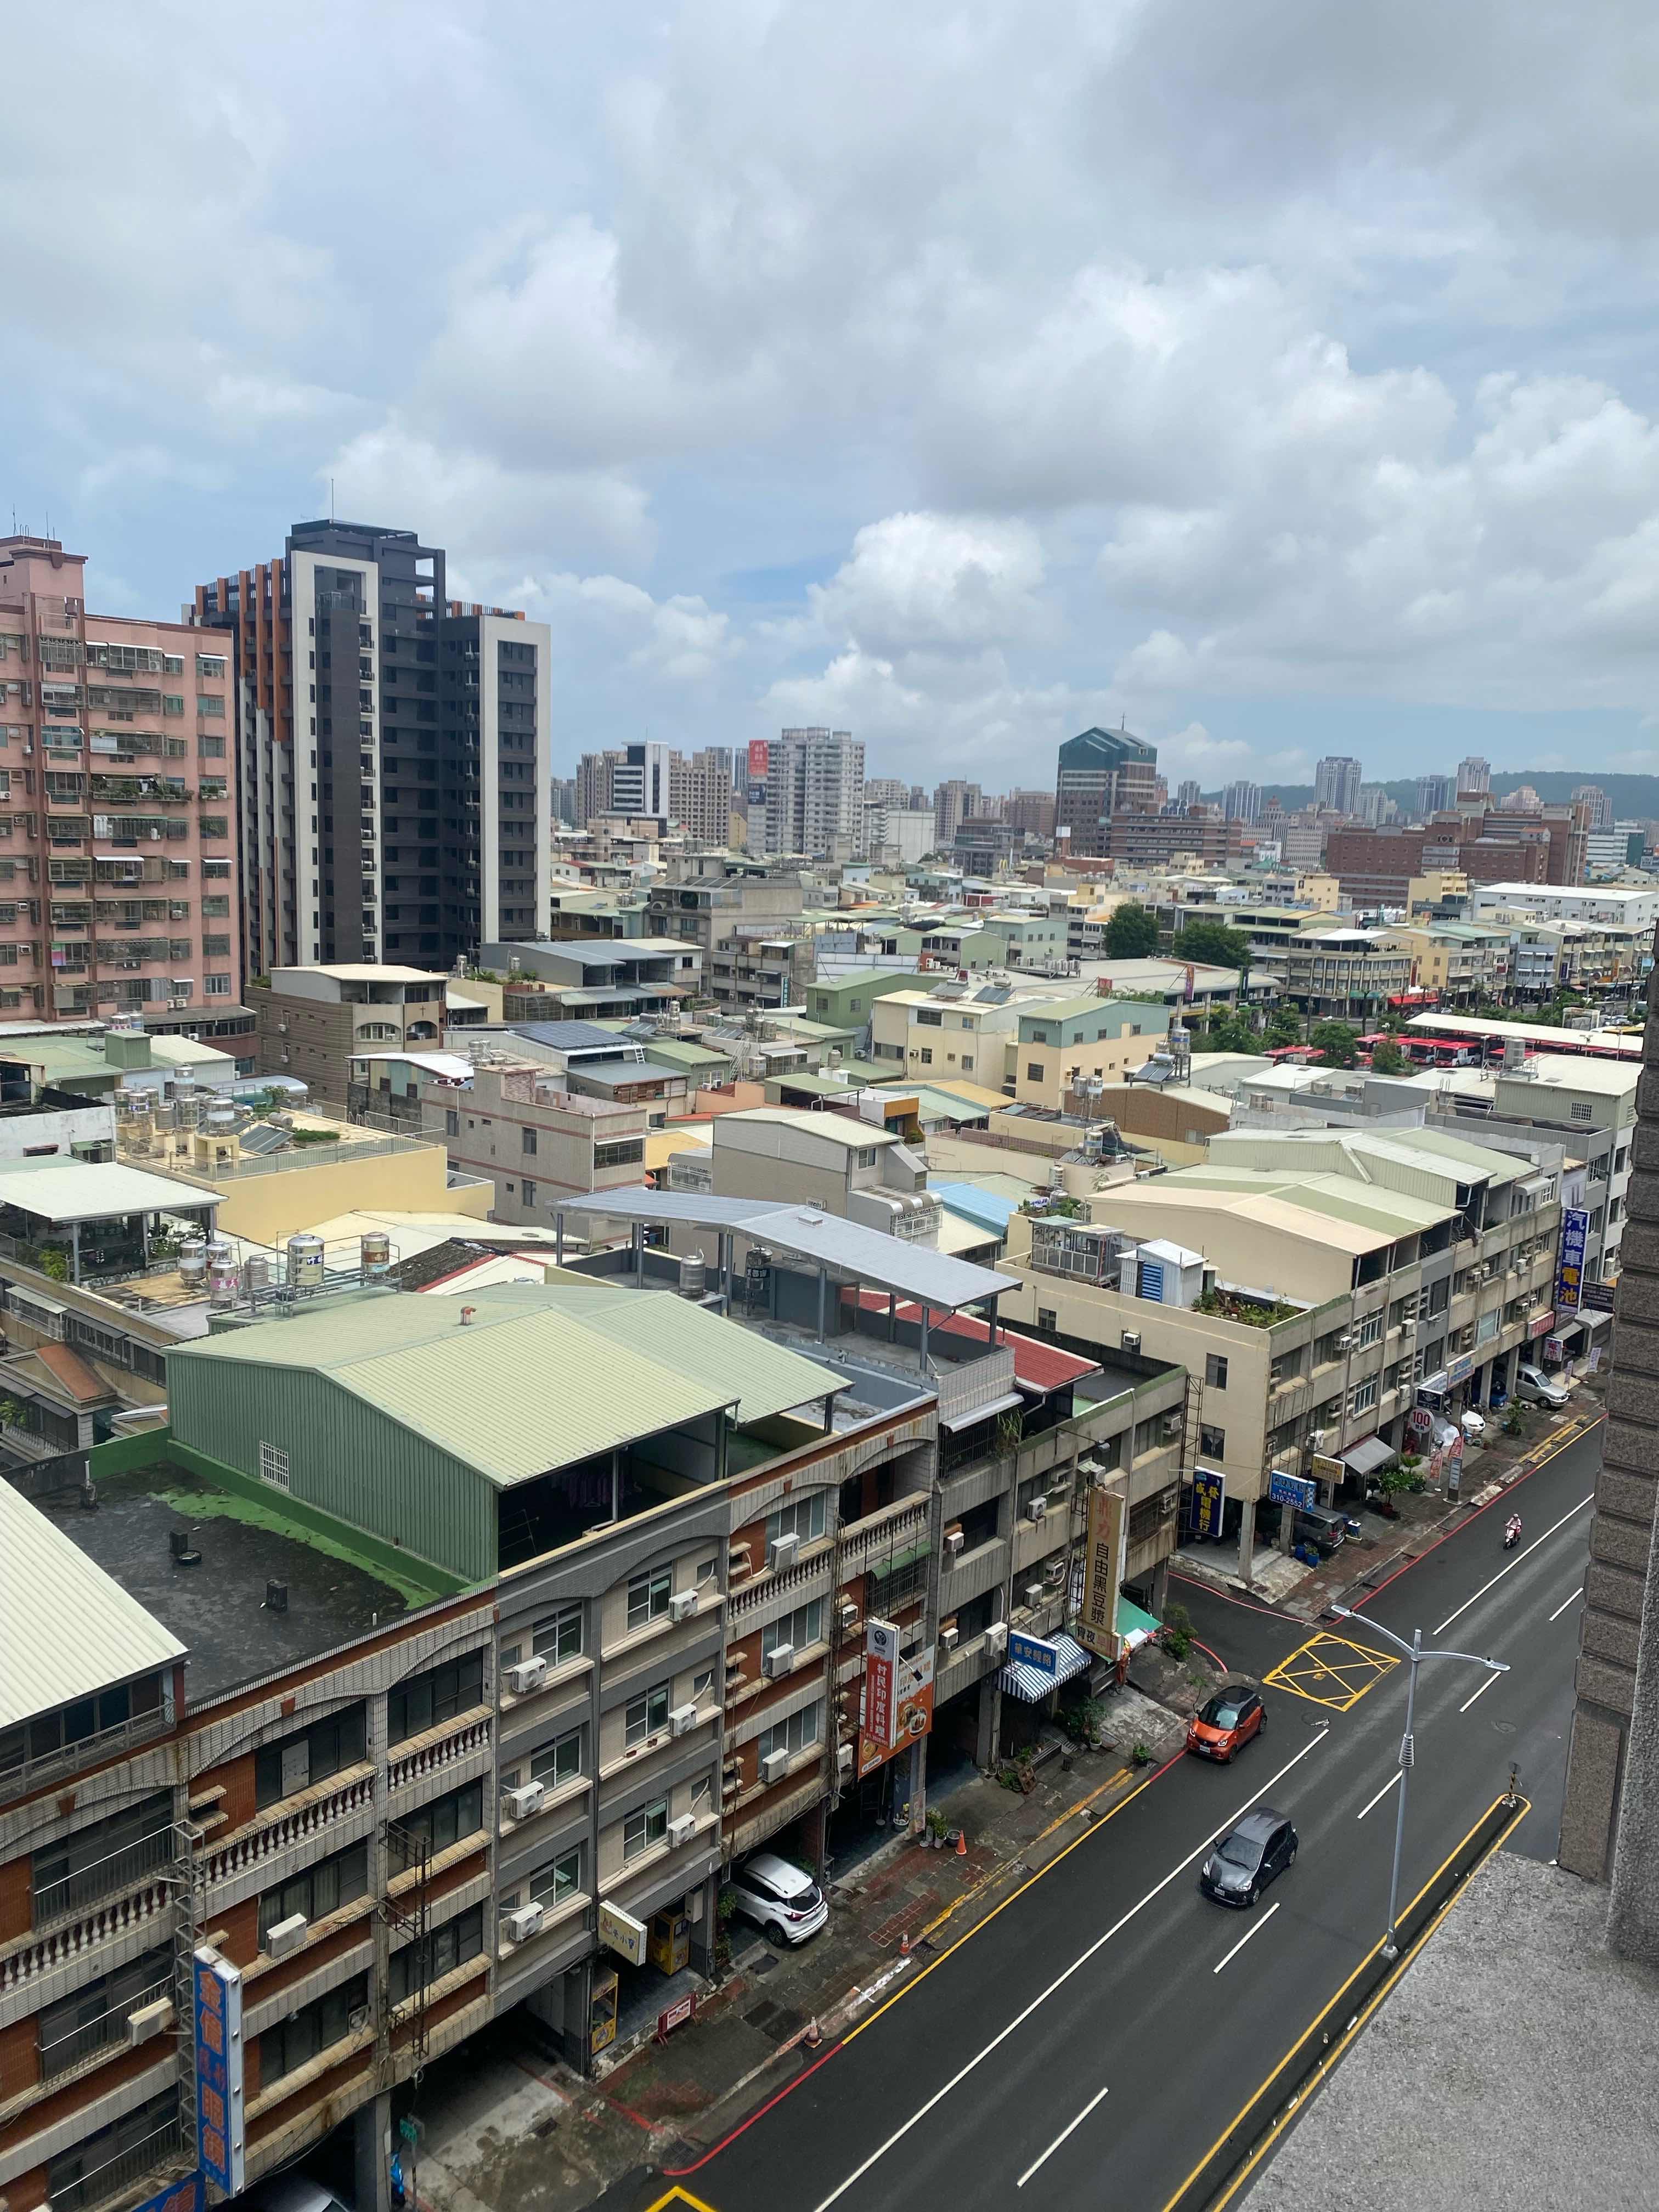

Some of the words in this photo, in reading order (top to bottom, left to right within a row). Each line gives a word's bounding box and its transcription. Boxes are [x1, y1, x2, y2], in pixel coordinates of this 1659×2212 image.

[1560, 1211, 1585, 1305] 汽機車電池
[1413, 1412, 1430, 1426] 100
[1272, 1493, 1302, 1508] 310-2552
[874, 1663, 887, 1738] 村民印度料理
